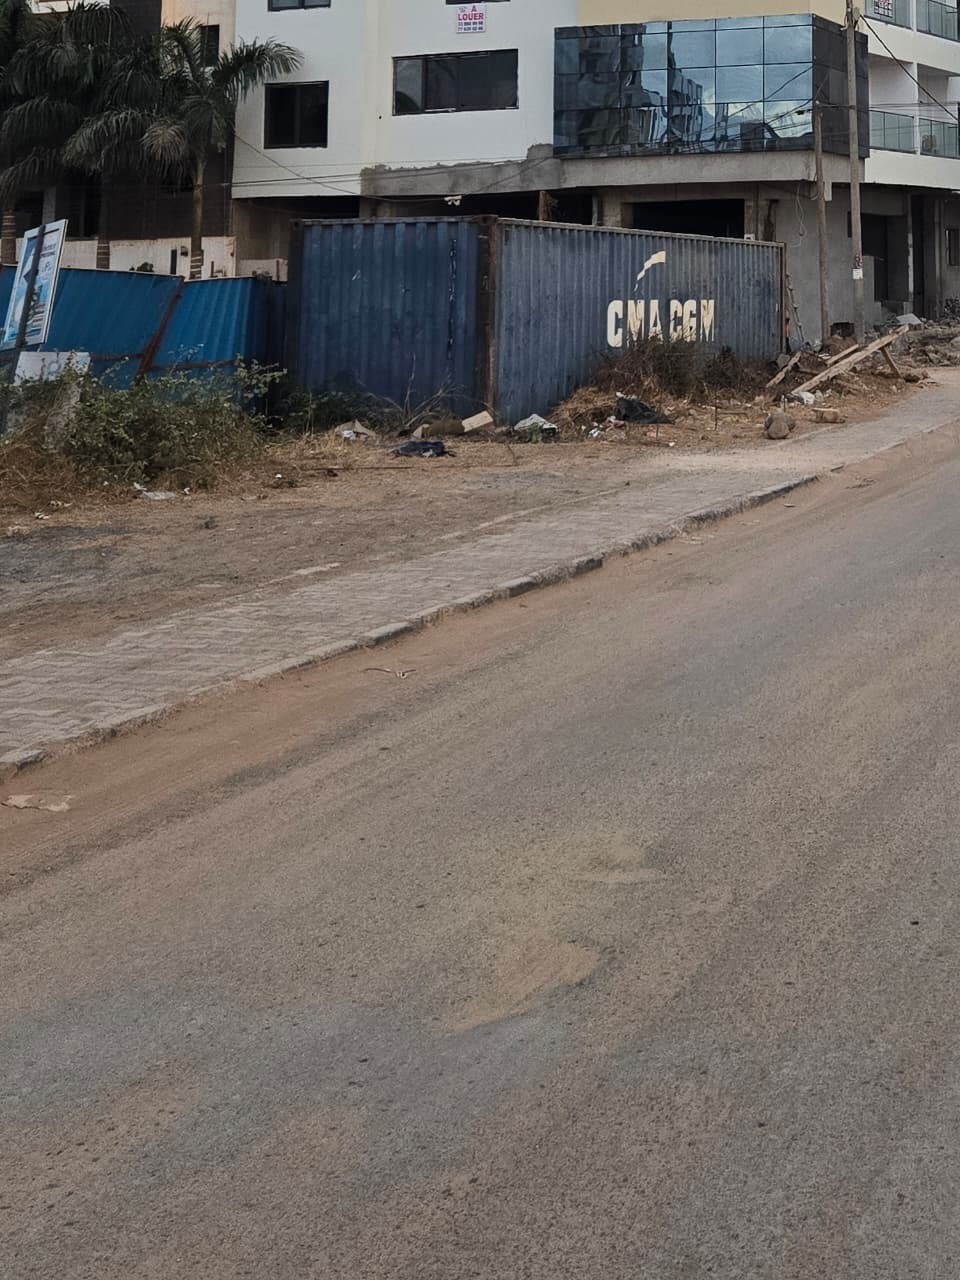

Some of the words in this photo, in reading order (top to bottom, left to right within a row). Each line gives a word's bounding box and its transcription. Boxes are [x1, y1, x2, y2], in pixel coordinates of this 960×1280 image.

[457, 12, 484, 21] LOUER
[606, 299, 663, 349] CMA
[669, 299, 715, 343] CGM
